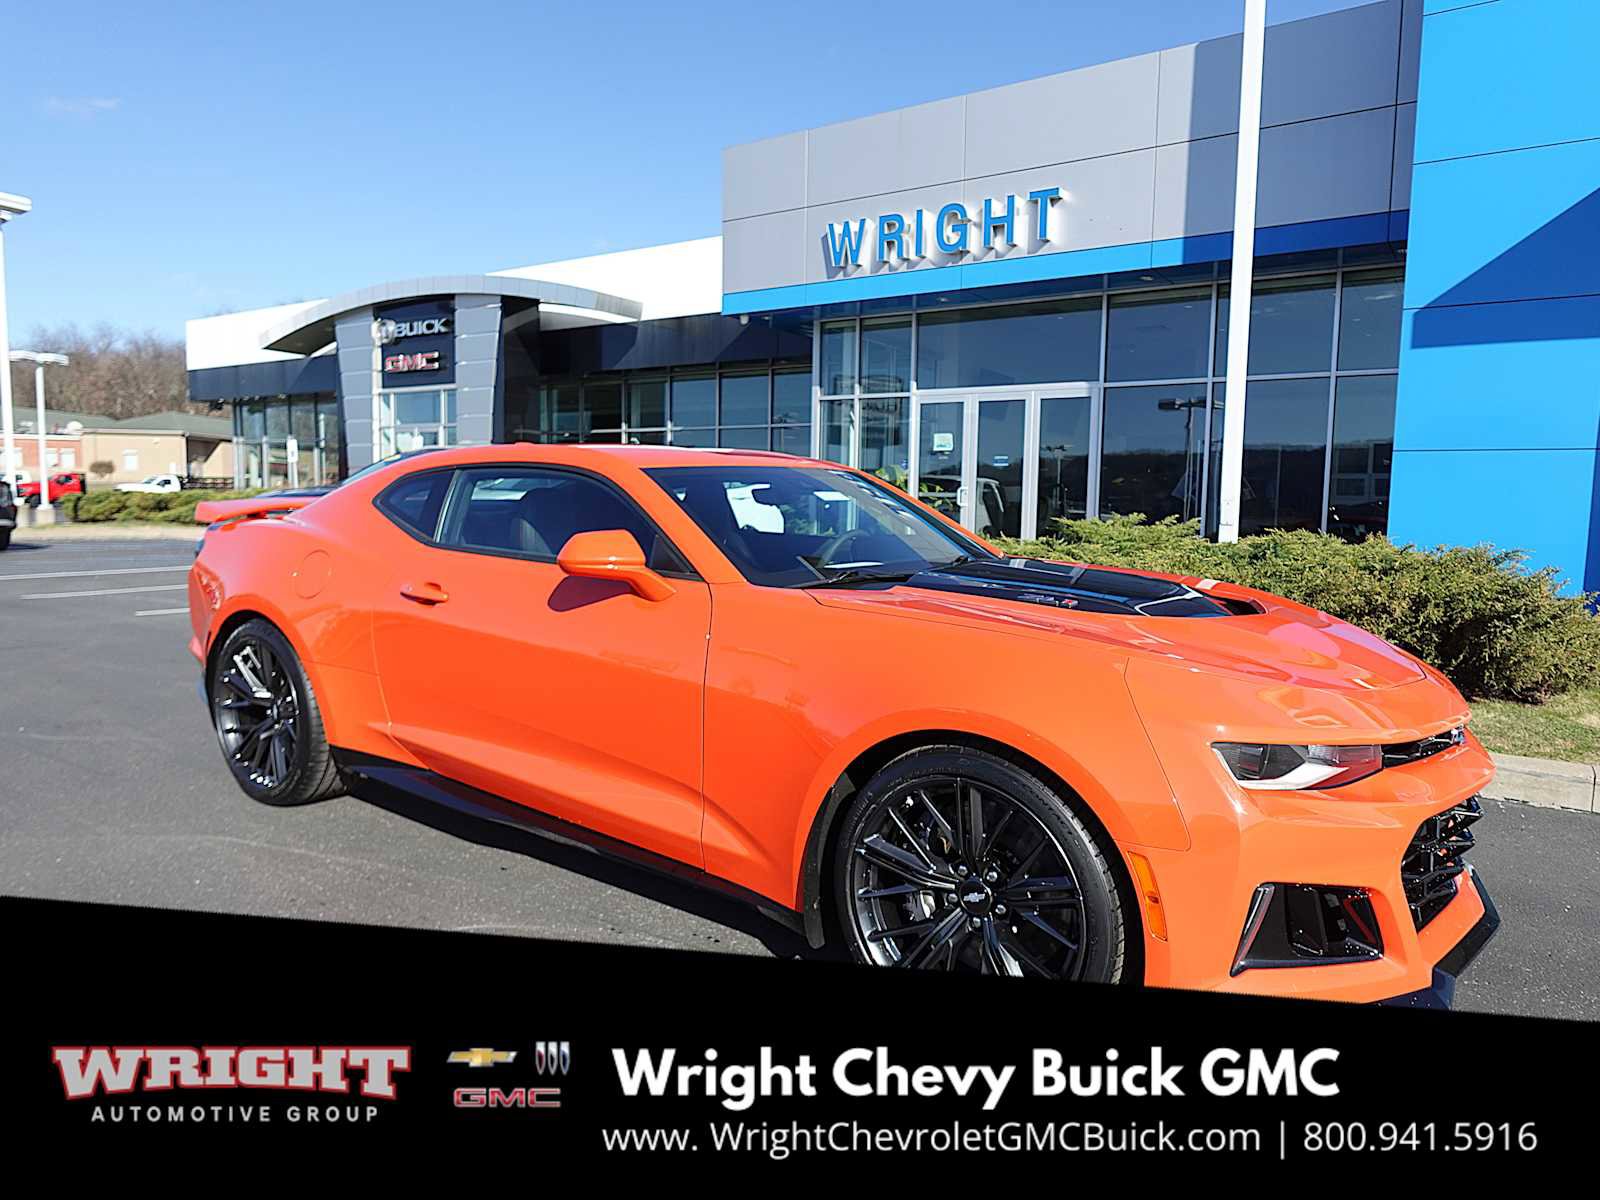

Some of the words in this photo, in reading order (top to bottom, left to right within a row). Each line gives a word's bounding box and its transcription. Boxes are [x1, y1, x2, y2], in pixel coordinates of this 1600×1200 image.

[826, 186, 1064, 268] WRIGHT
[394, 318, 449, 338] BUICK
[384, 351, 440, 373] GMC
